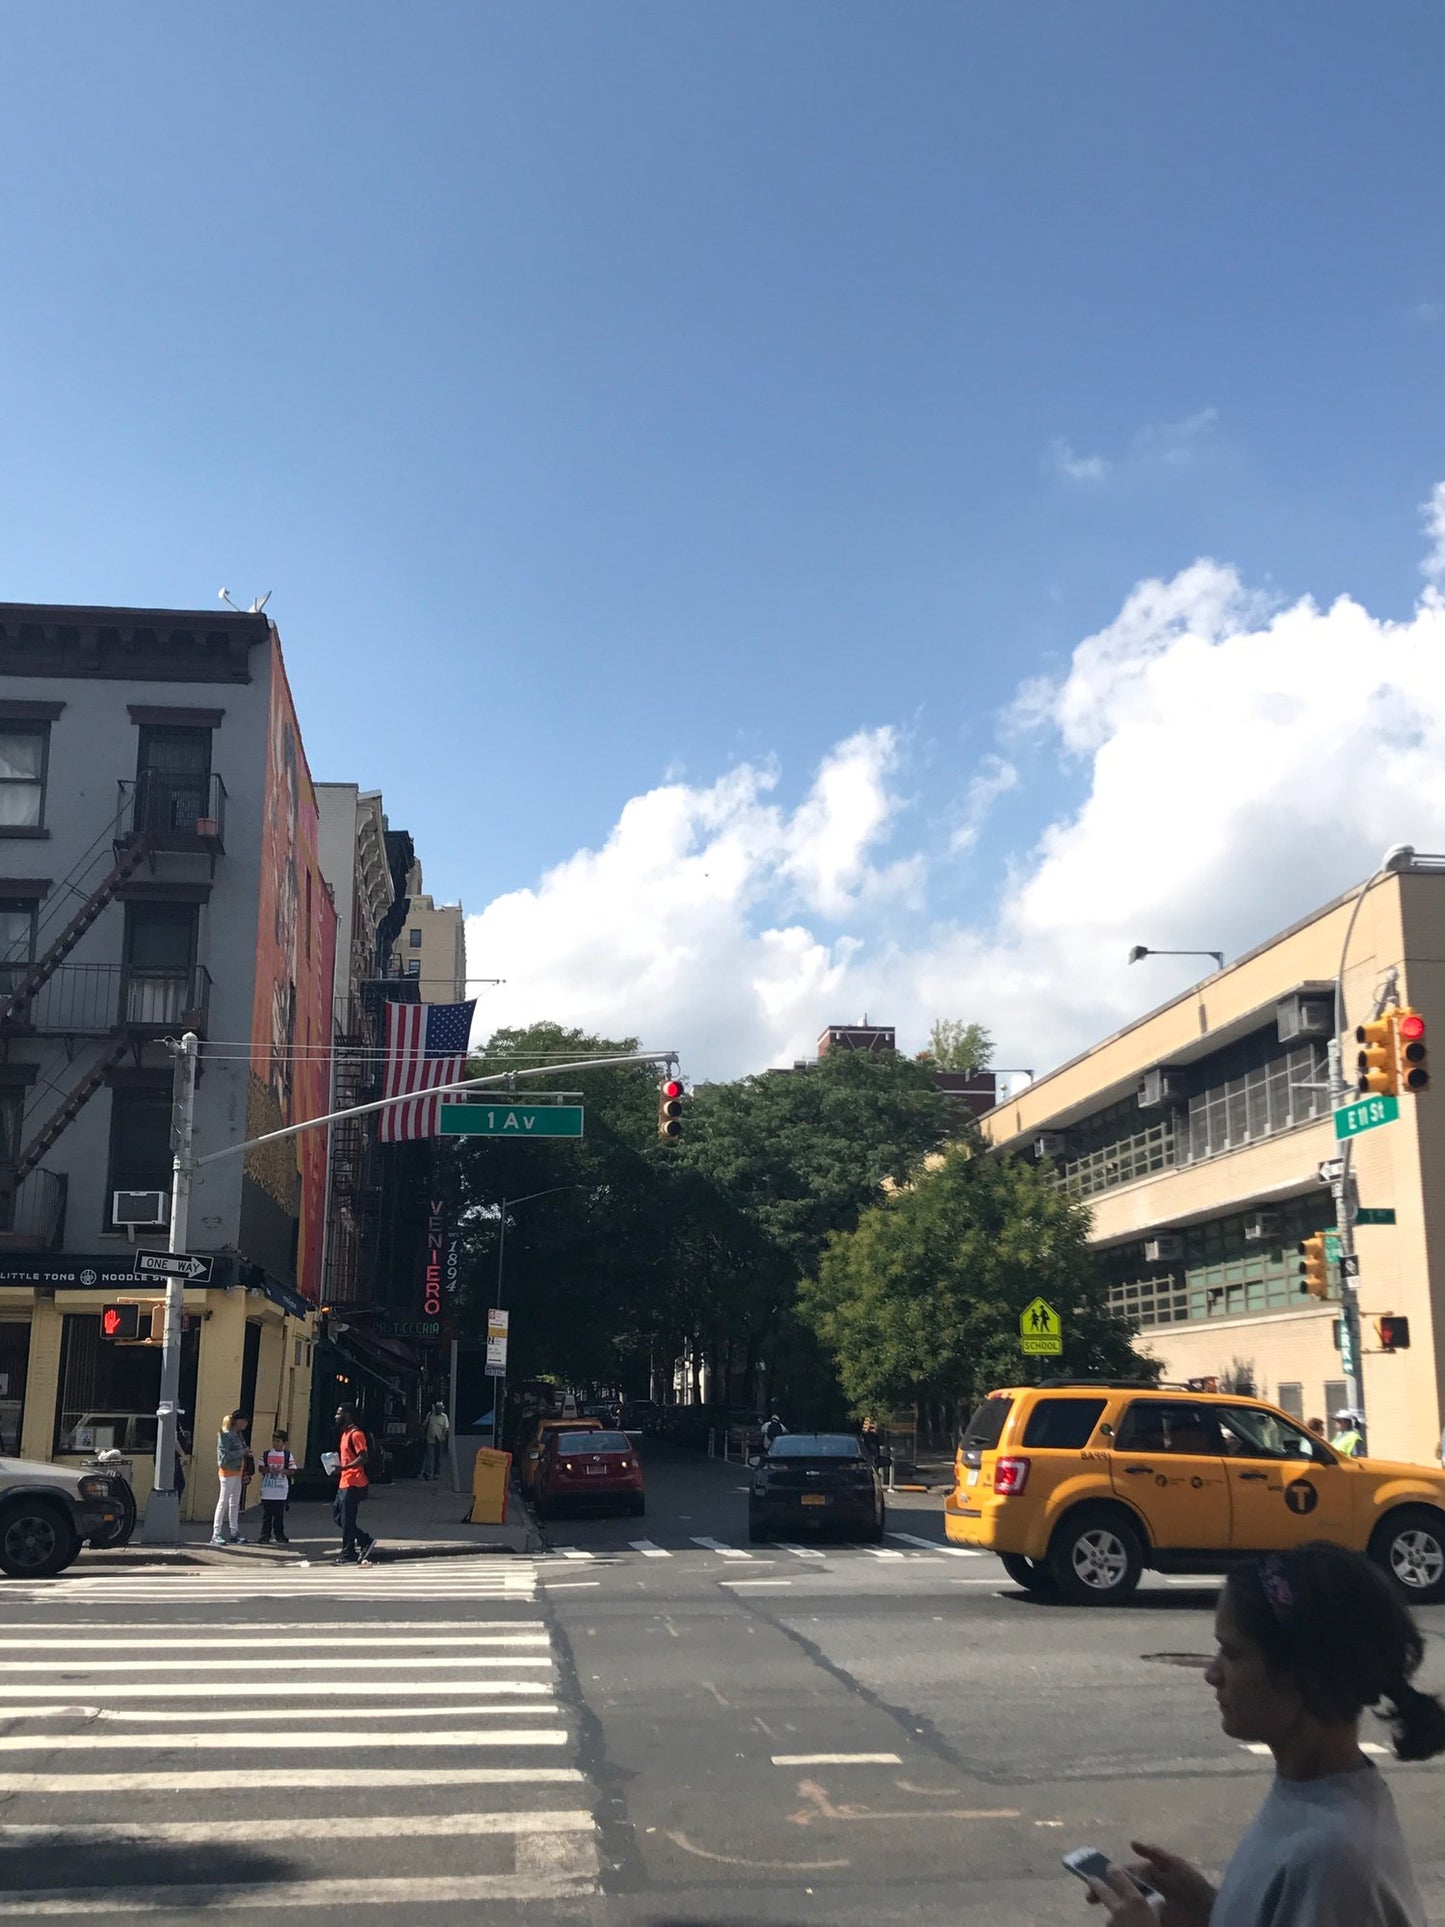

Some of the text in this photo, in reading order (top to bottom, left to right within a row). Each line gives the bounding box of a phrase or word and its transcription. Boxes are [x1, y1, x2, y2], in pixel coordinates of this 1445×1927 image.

[487, 1111, 536, 1130] 1 Av
[1347, 1100, 1385, 1130] E 11 St
[146, 1257, 200, 1273] ONE WAY
[424, 1200, 443, 1315] VENIERO
[445, 1240, 458, 1292] 1894
[0, 1272, 40, 1280] LITTLE
[44, 1273, 75, 1281] TONG
[101, 1273, 148, 1281] NOODLE
[1024, 1341, 1058, 1351] SCHOOL
